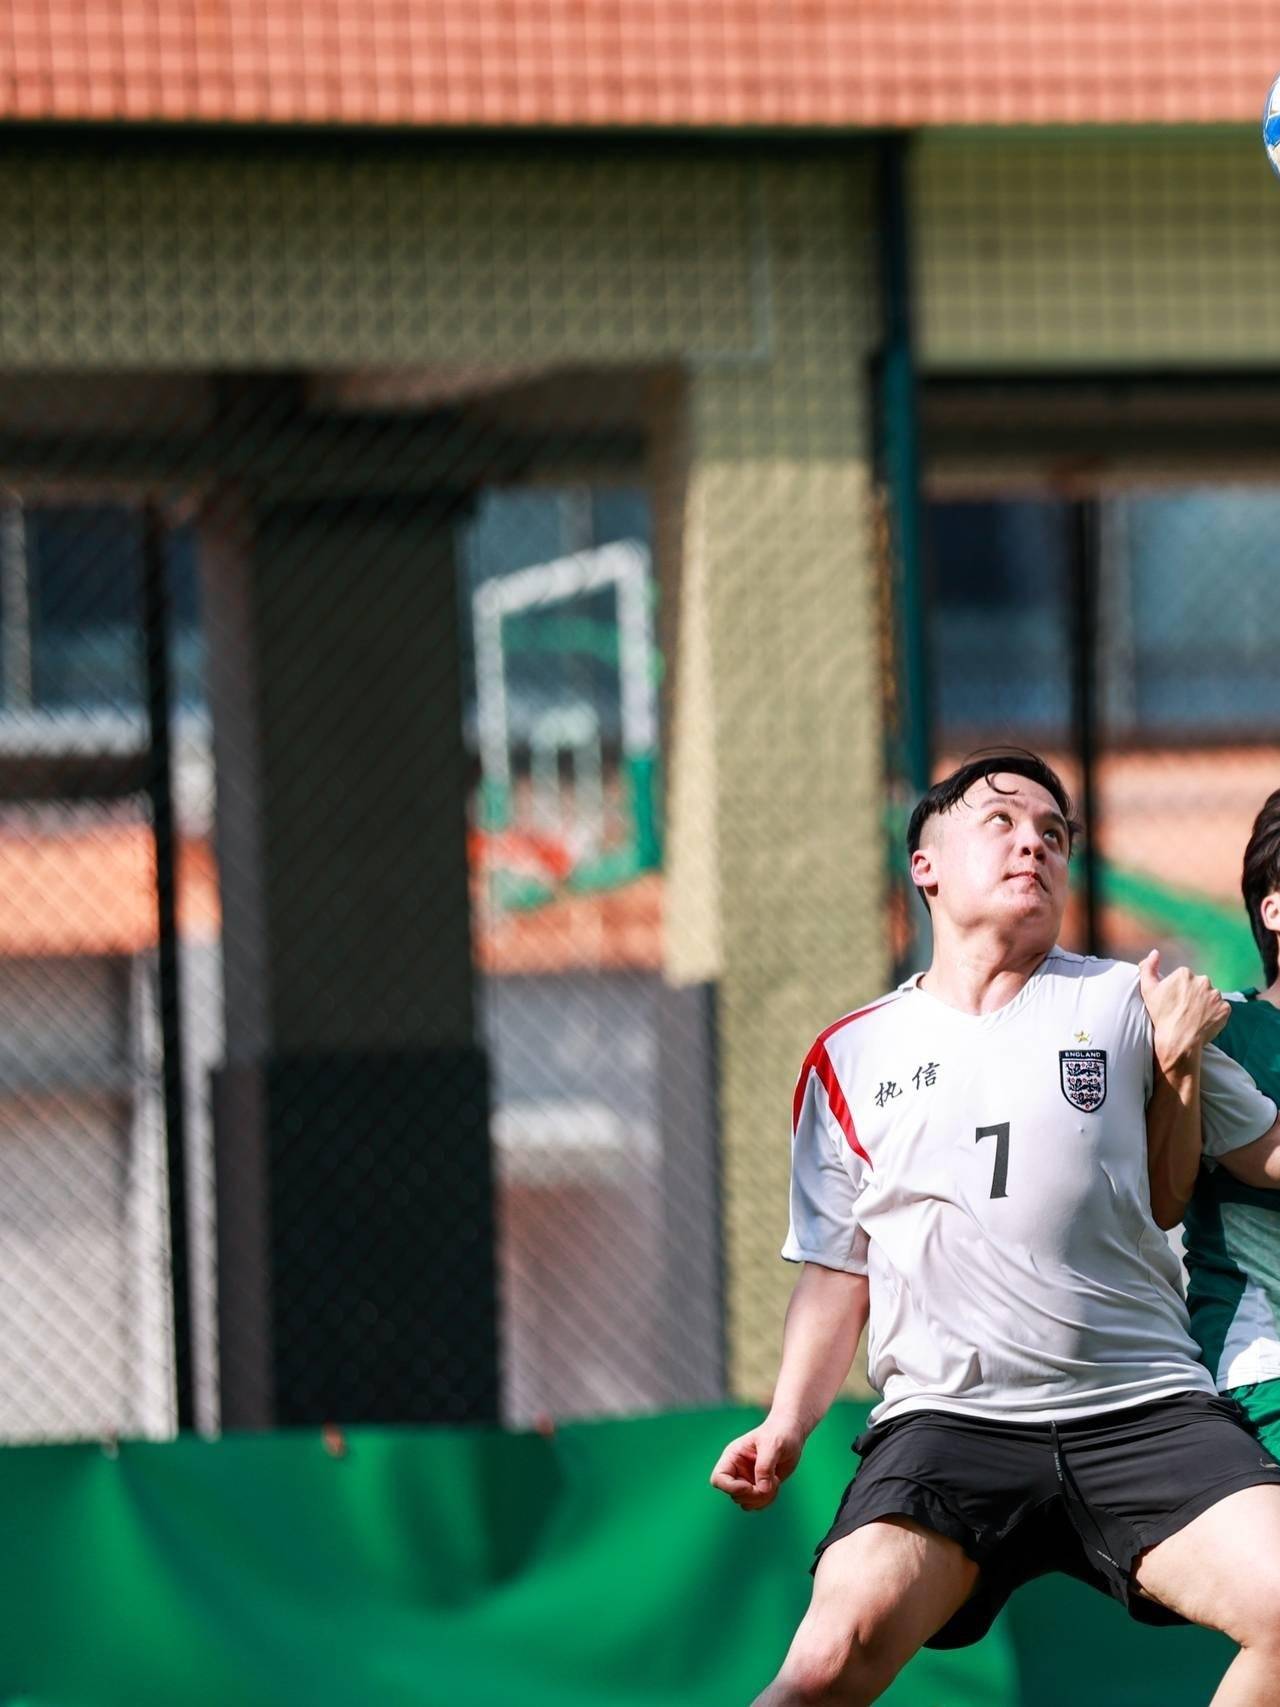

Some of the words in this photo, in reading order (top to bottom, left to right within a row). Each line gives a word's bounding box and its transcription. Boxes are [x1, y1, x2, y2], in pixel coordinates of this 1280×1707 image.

[1064, 1051, 1102, 1059] ENGLAND
[874, 1061, 941, 1108] 执信
[975, 1121, 1011, 1200] 7
